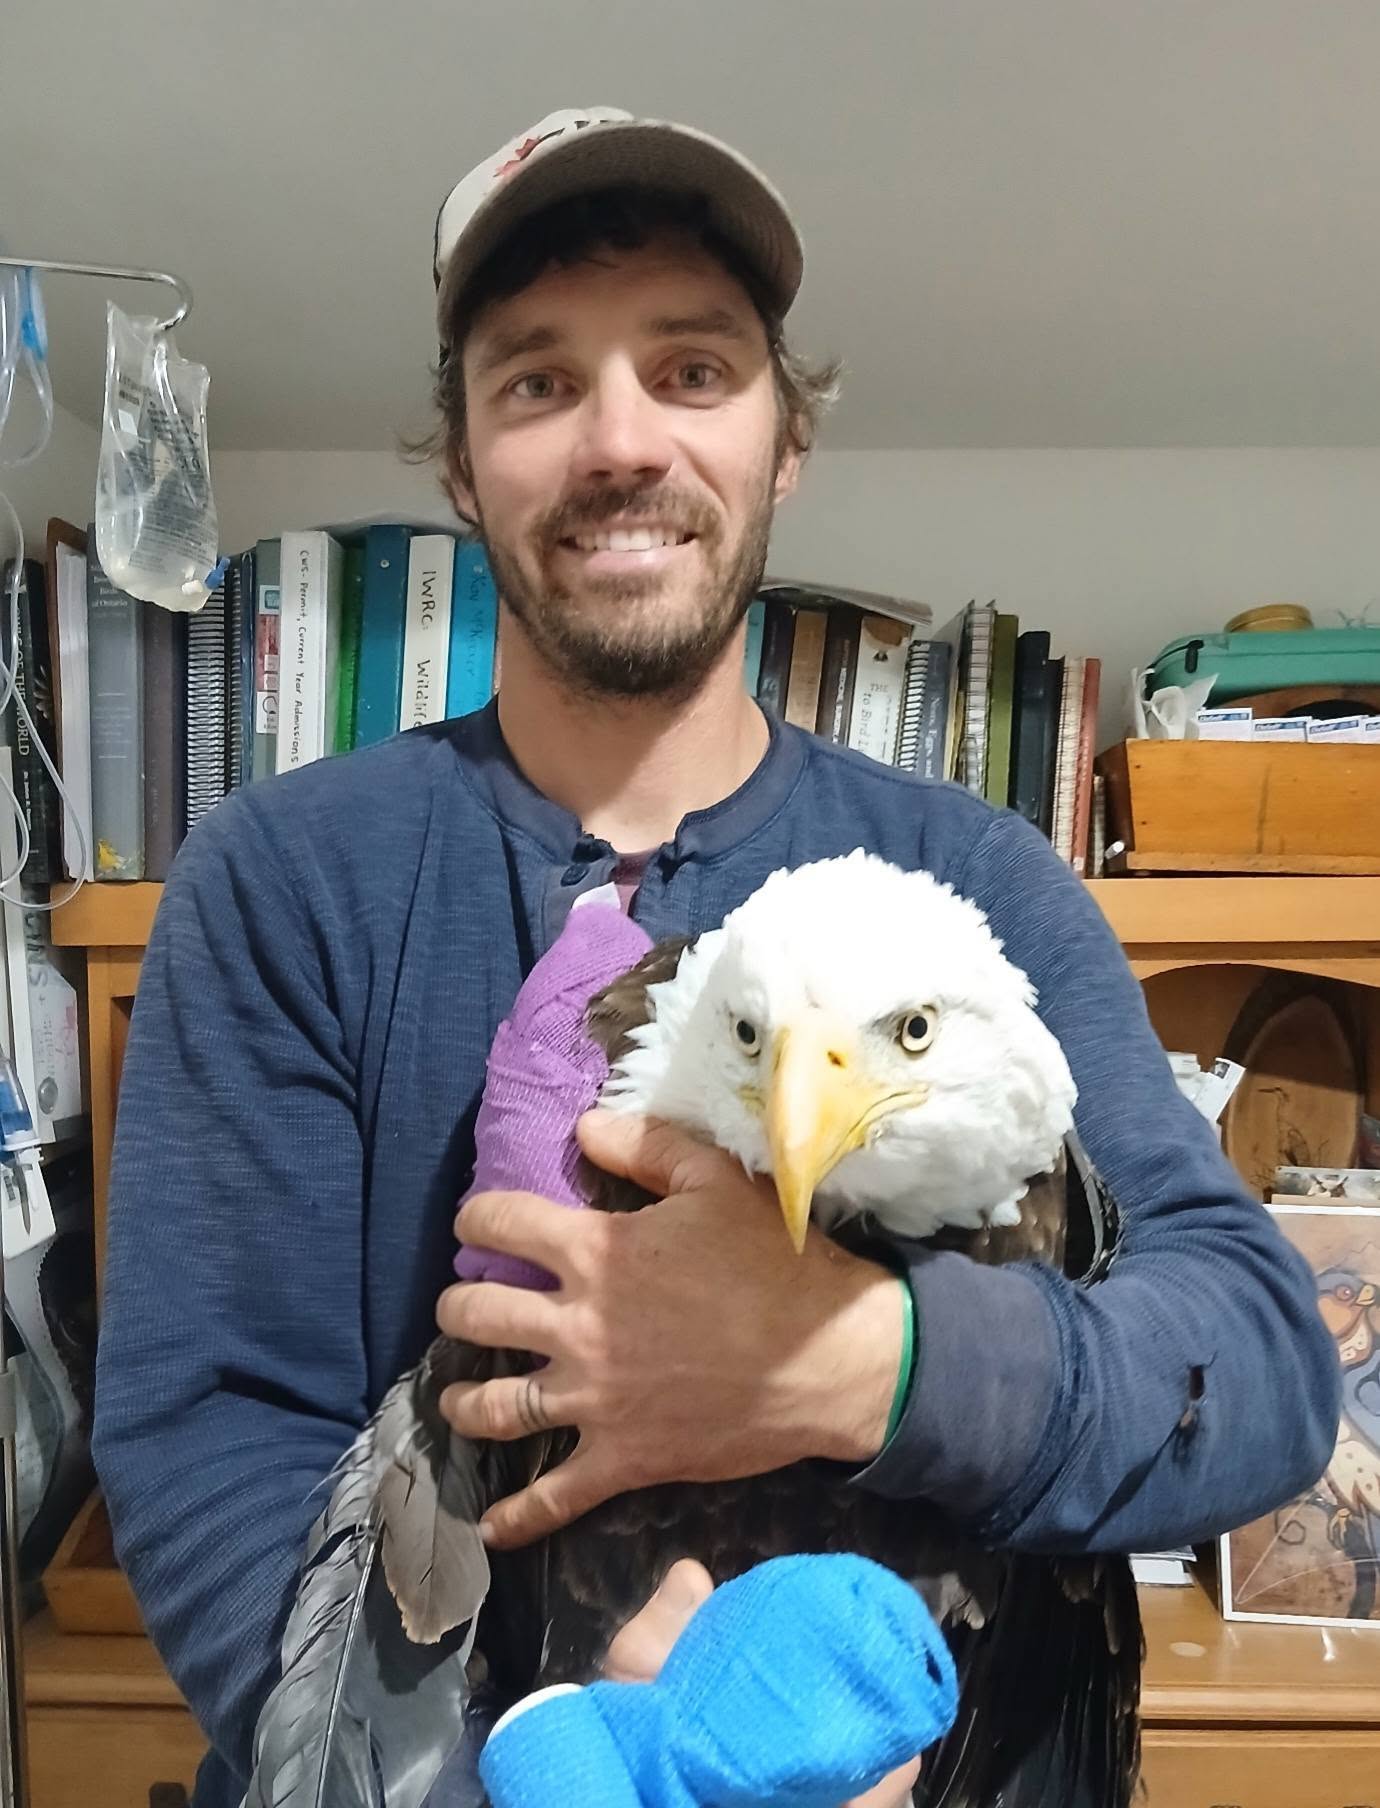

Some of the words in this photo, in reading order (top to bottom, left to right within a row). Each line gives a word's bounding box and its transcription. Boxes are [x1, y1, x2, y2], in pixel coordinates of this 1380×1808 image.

[296, 626, 307, 665] Current
[294, 672, 305, 694] Year
[290, 700, 303, 763] Admissions
